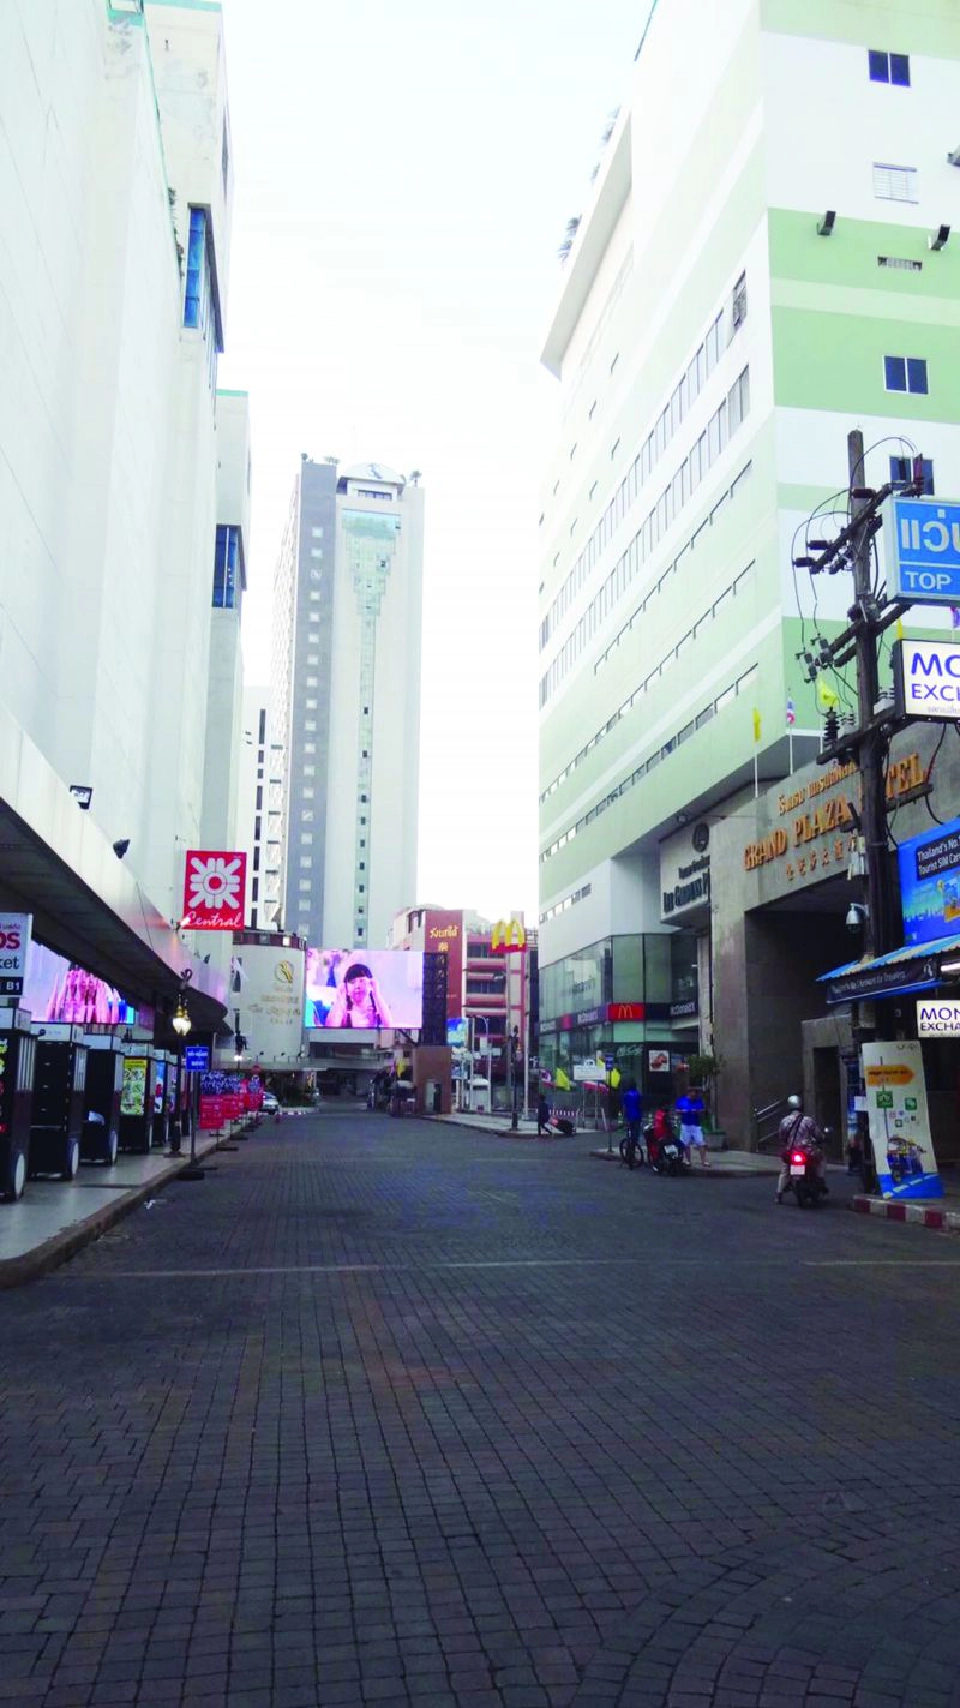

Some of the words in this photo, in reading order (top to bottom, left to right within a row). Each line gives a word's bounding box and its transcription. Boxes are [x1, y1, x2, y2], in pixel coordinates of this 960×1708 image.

[904, 570, 952, 590] TOP
[911, 683, 960, 701] EXC
[744, 827, 788, 871] GRAND
[793, 794, 853, 847] PLAZA
[188, 910, 242, 928] Central
